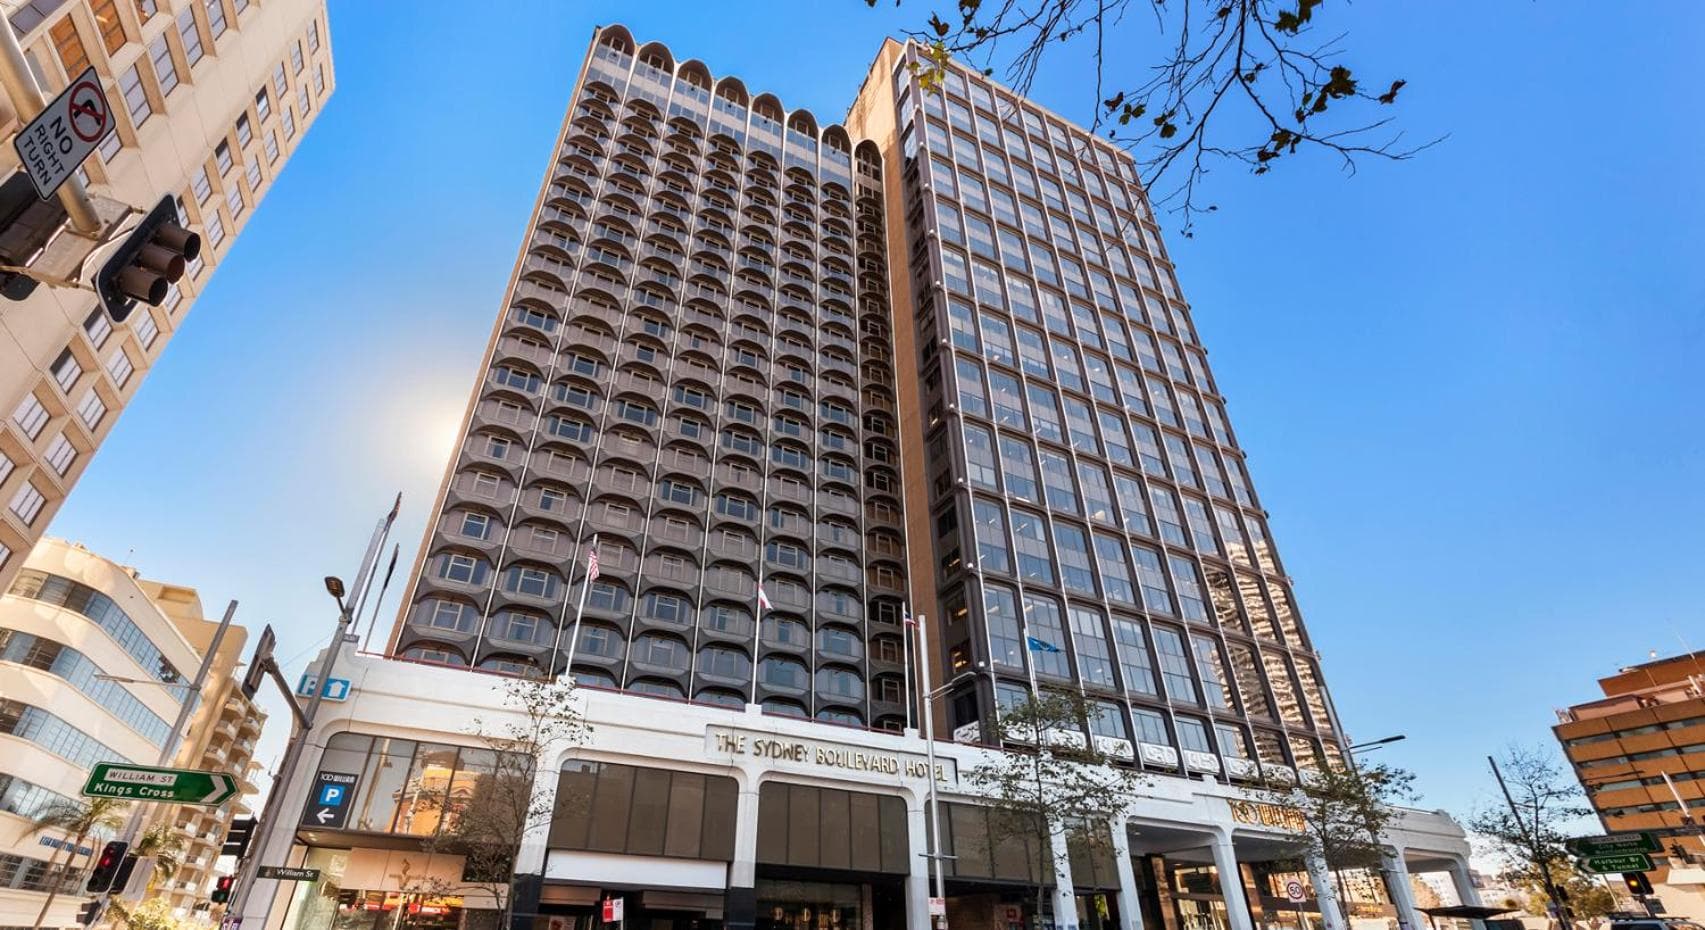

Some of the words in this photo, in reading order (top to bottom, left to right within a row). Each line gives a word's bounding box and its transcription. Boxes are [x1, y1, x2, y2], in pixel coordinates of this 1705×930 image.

[49, 116, 73, 154] NO
[34, 124, 65, 174] RIGHT
[23, 136, 52, 185] TURN
[716, 733, 745, 755] THE
[753, 738, 810, 762] SYDNEY
[816, 747, 900, 775] BOULEVARD
[109, 770, 155, 782] WILLIAM
[160, 775, 173, 783] ST
[94, 782, 132, 796] Kings
[139, 786, 175, 798] Cross
[325, 788, 340, 802] P
[277, 869, 304, 877] William
[1290, 887, 1300, 895] 50
